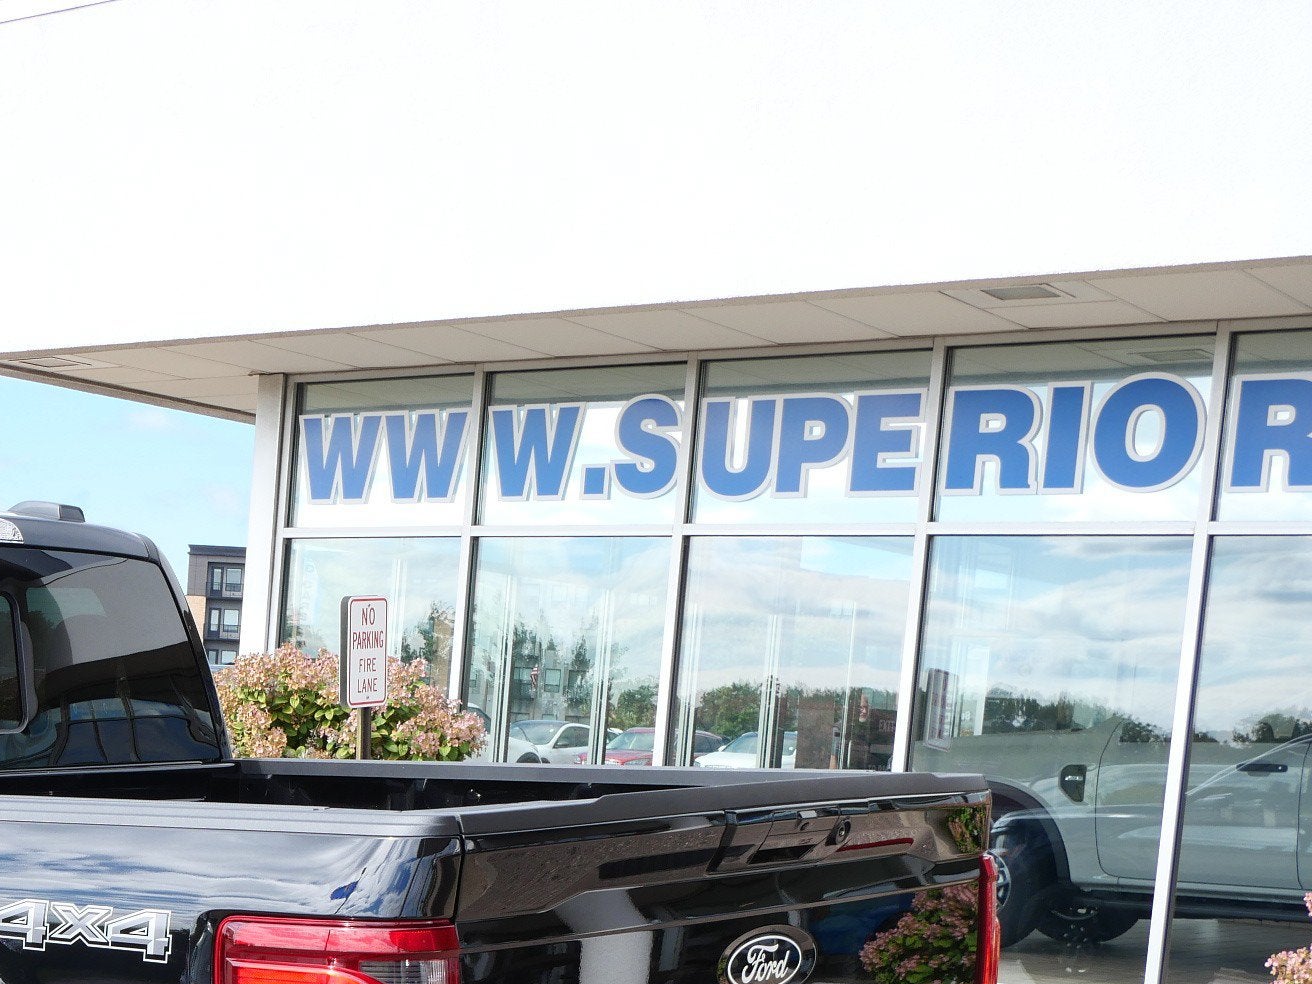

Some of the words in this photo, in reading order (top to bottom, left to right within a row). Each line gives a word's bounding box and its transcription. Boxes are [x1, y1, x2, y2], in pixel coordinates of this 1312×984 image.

[361, 607, 376, 626] NO
[352, 630, 384, 650] PARKING
[358, 657, 377, 673] FIRE
[357, 677, 378, 694] LANE
[741, 943, 791, 984] Ford
